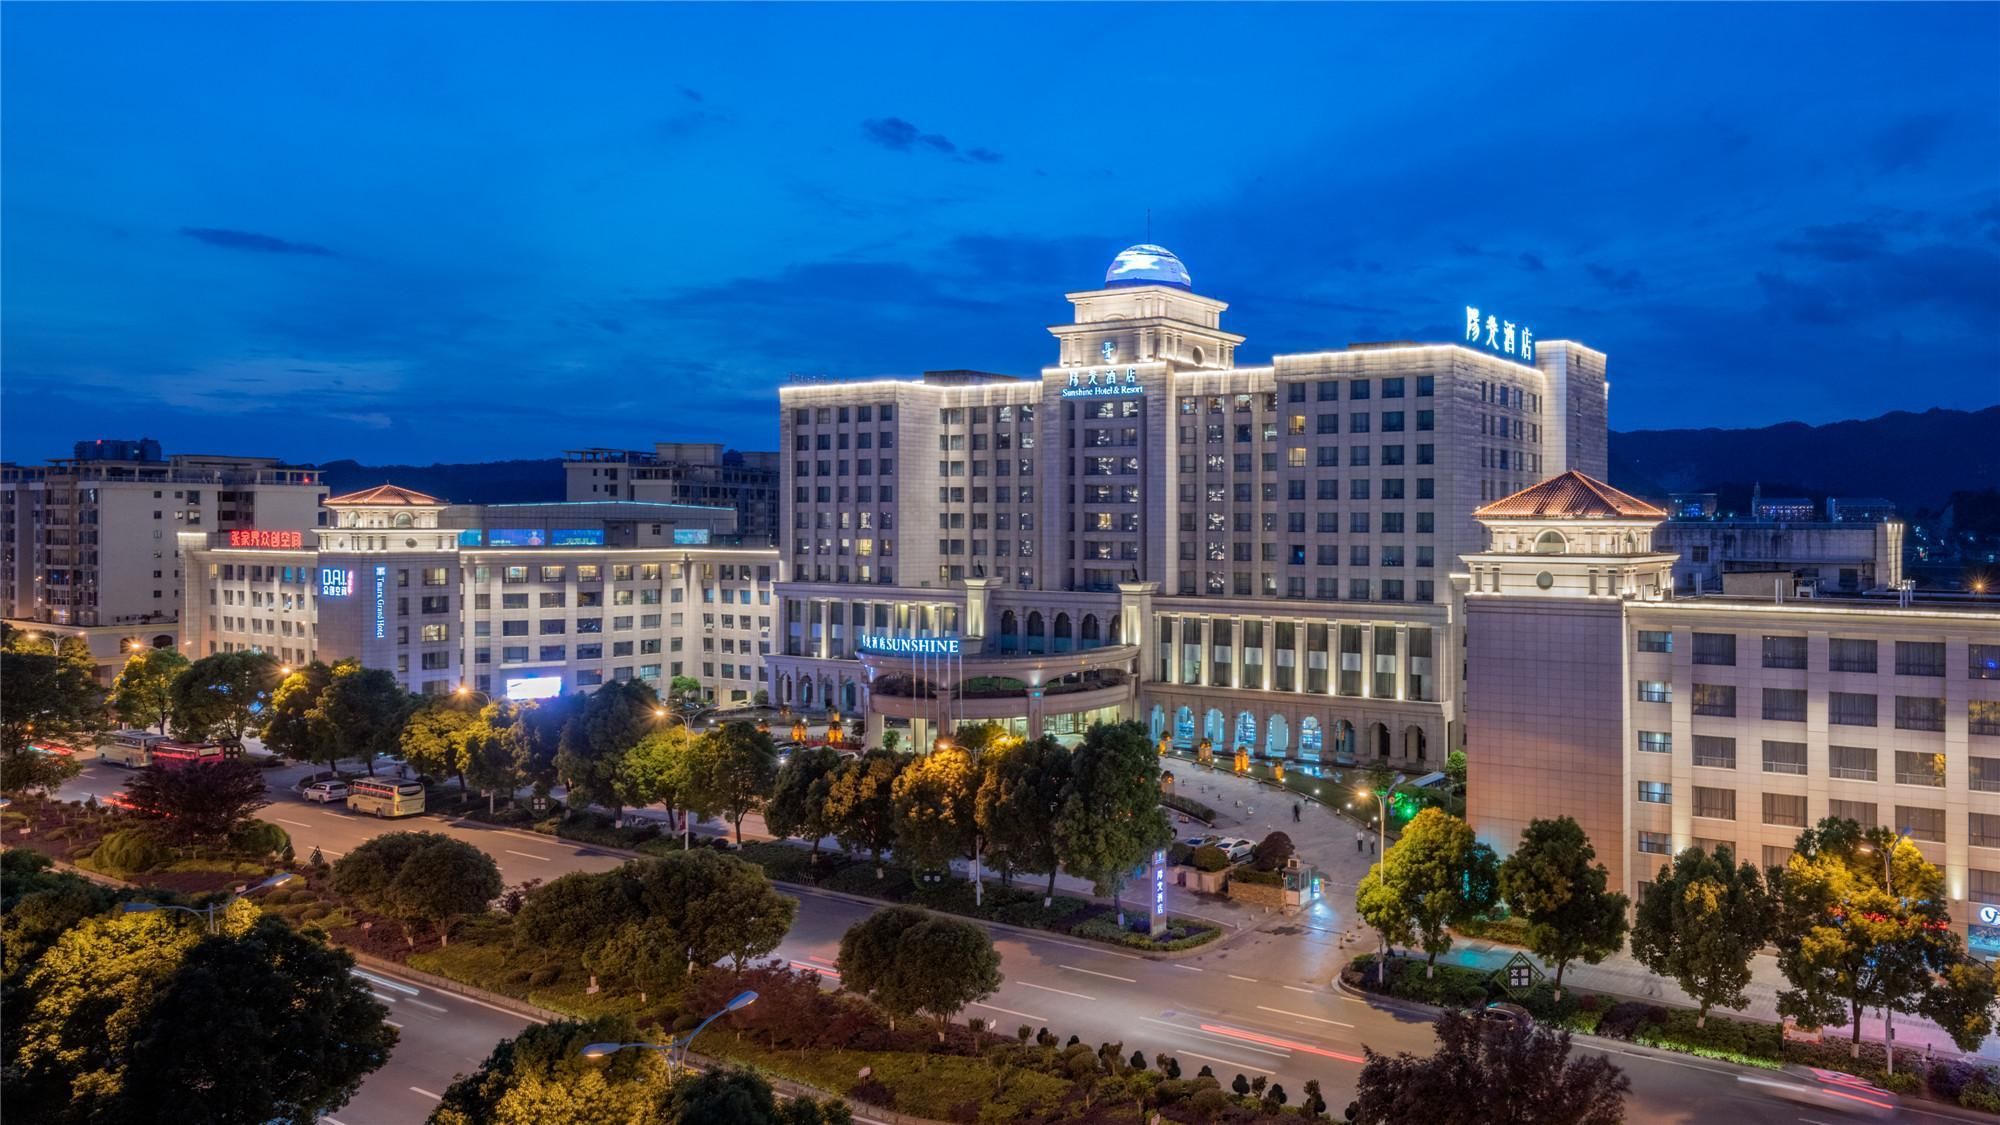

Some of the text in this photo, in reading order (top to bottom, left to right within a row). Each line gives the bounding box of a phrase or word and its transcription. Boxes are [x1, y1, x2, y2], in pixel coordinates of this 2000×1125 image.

[1062, 385, 1143, 397] Sunshine Hotel & Resort
[377, 599, 385, 619] Grand
[377, 620, 385, 638] Hotel
[886, 638, 959, 652] SUNSHINE
